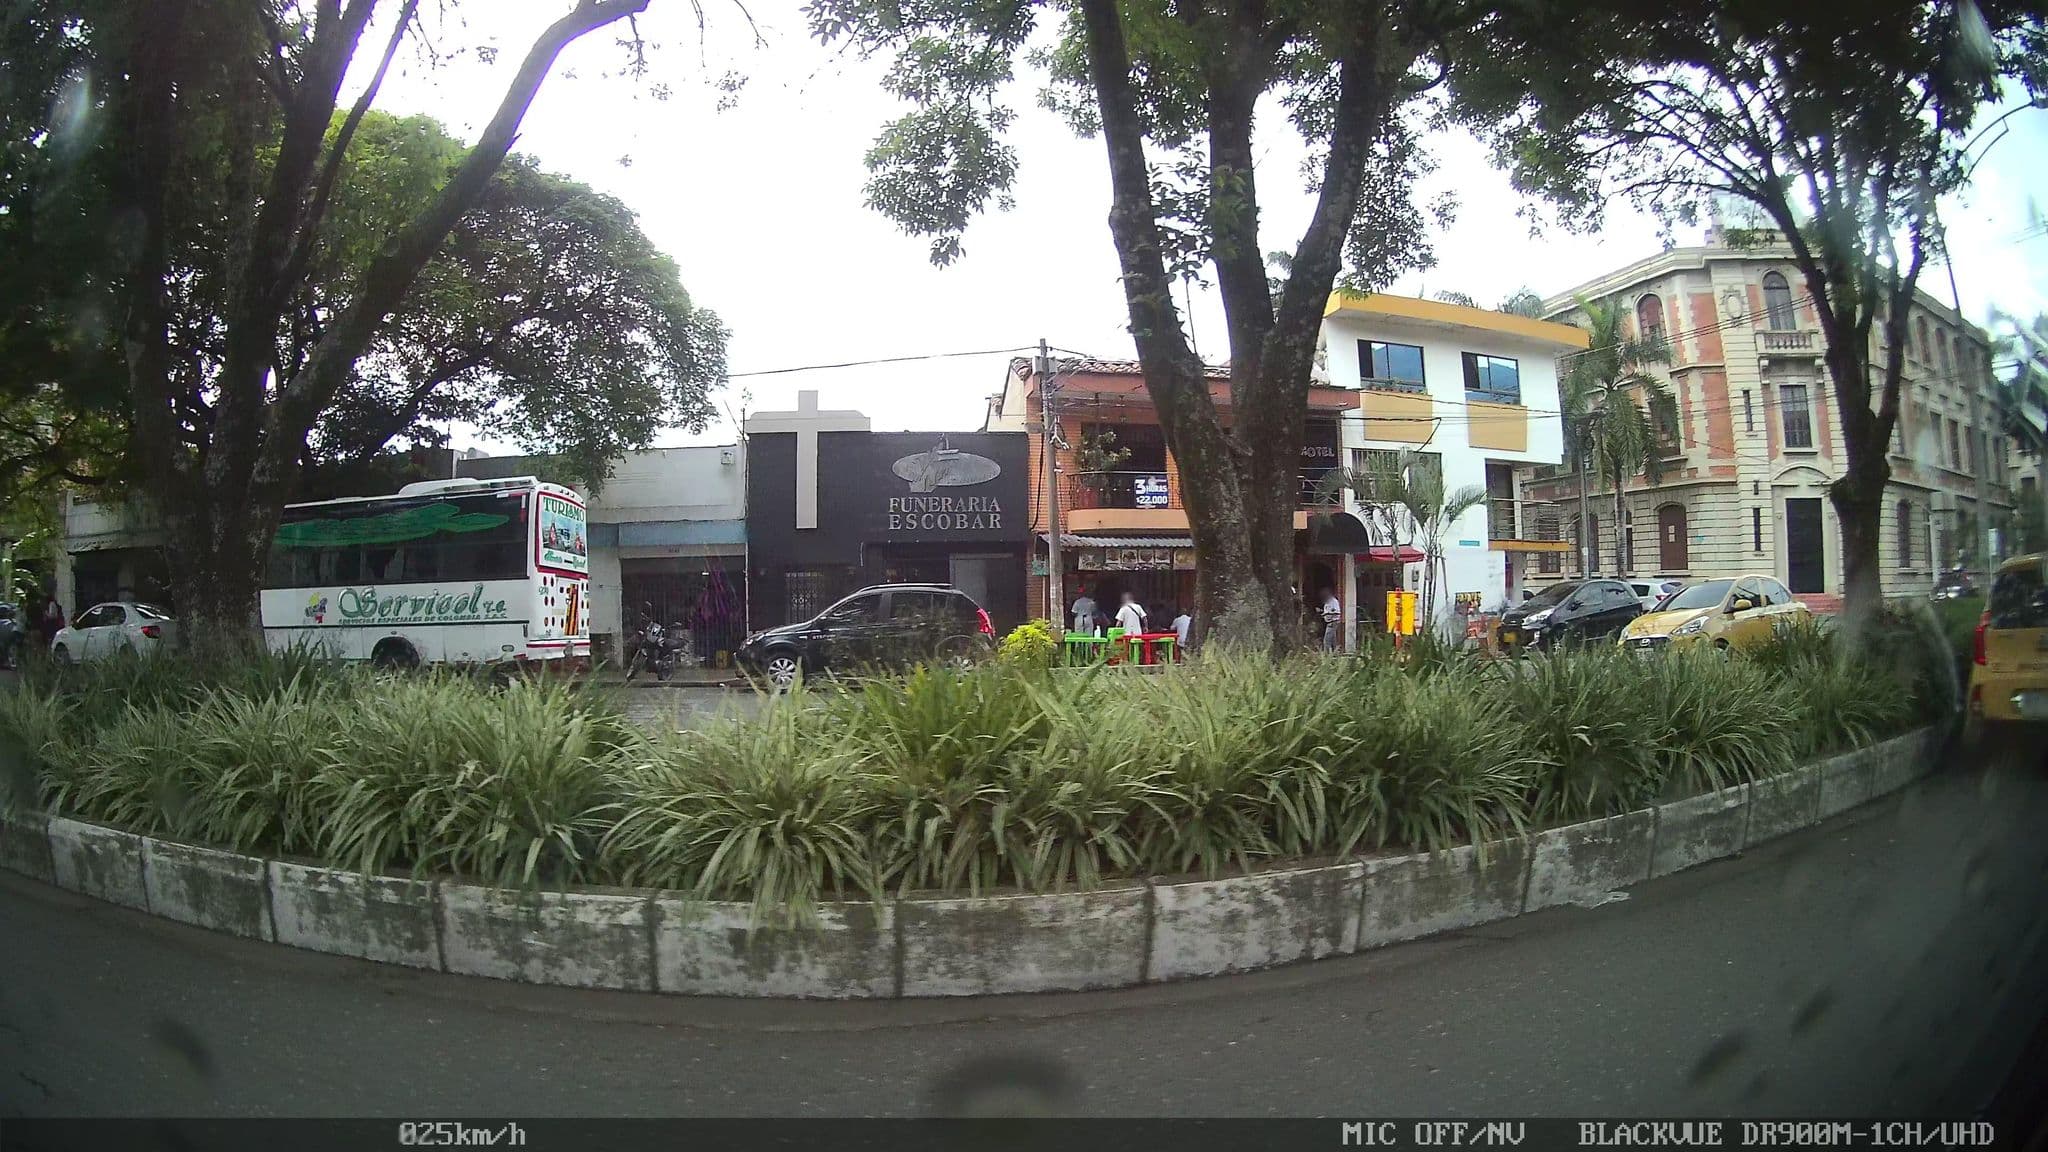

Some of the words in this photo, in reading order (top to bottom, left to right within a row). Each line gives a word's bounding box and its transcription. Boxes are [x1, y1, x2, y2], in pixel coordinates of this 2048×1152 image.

[1134, 479, 1146, 494] 3
[888, 496, 1002, 513] FUNERARIA
[888, 513, 1002, 530] ESCOBAR
